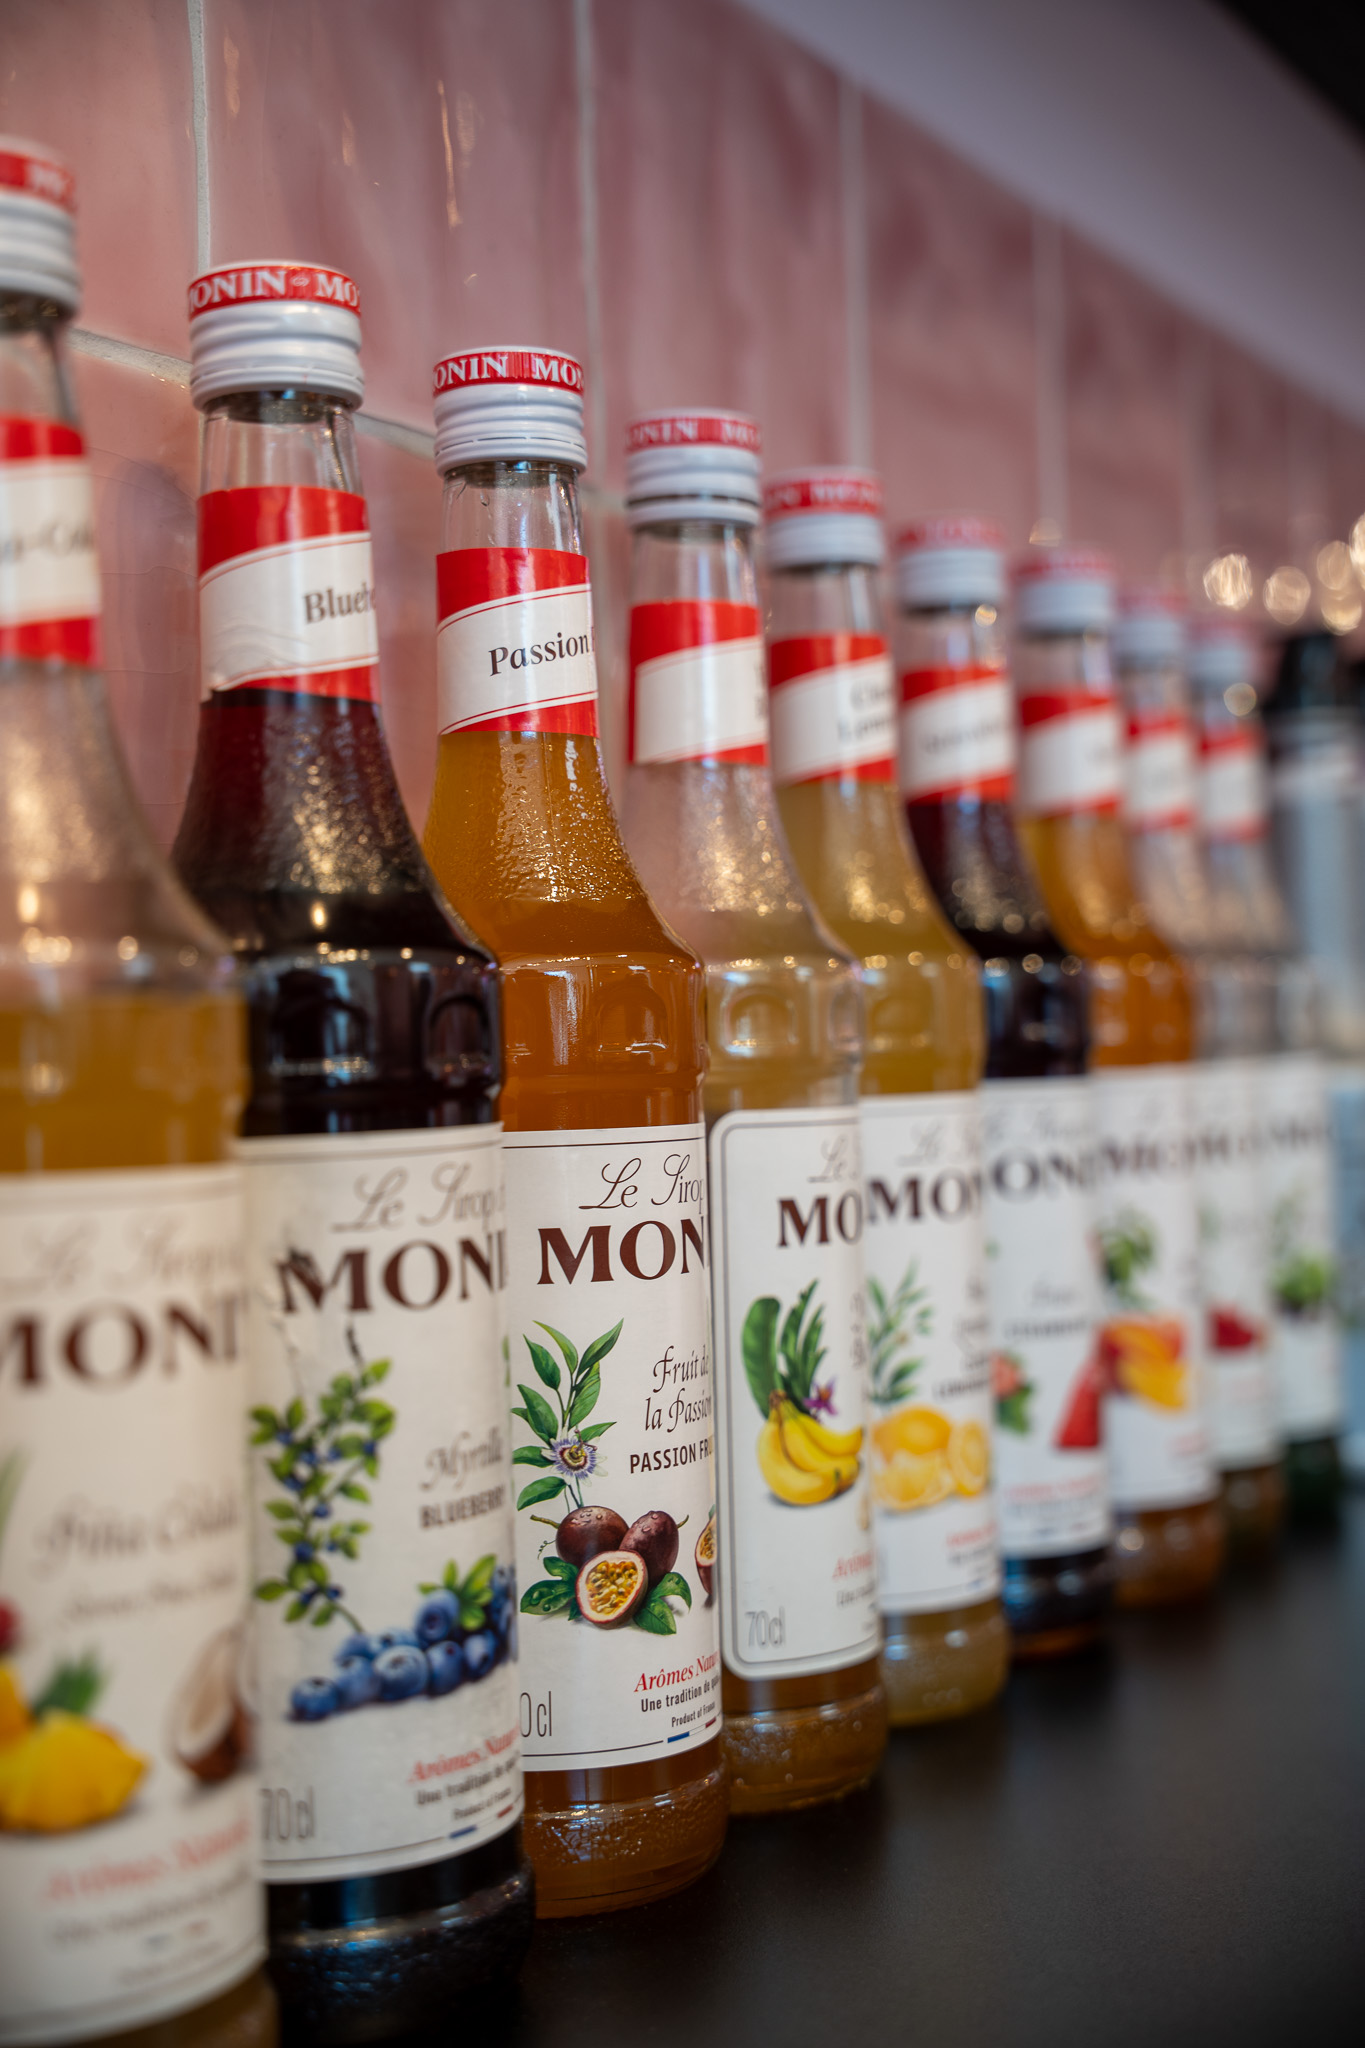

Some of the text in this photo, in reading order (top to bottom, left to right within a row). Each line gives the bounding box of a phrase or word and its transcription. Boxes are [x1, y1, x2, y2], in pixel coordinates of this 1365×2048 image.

[189, 269, 361, 313] ONIN MO
[433, 356, 508, 389] ONIN
[488, 632, 590, 677] Passion
[329, 1166, 409, 1233] Le
[579, 1157, 642, 1210] Le
[536, 1215, 709, 1286] MON
[652, 1345, 699, 1393] Fruit
[645, 1397, 663, 1431] la
[630, 1442, 697, 1474] PASSION
[633, 1667, 693, 1692] Arômes
[641, 1698, 662, 1713] Une
[665, 1686, 703, 1707] tradition
[671, 1711, 697, 1728] Product
